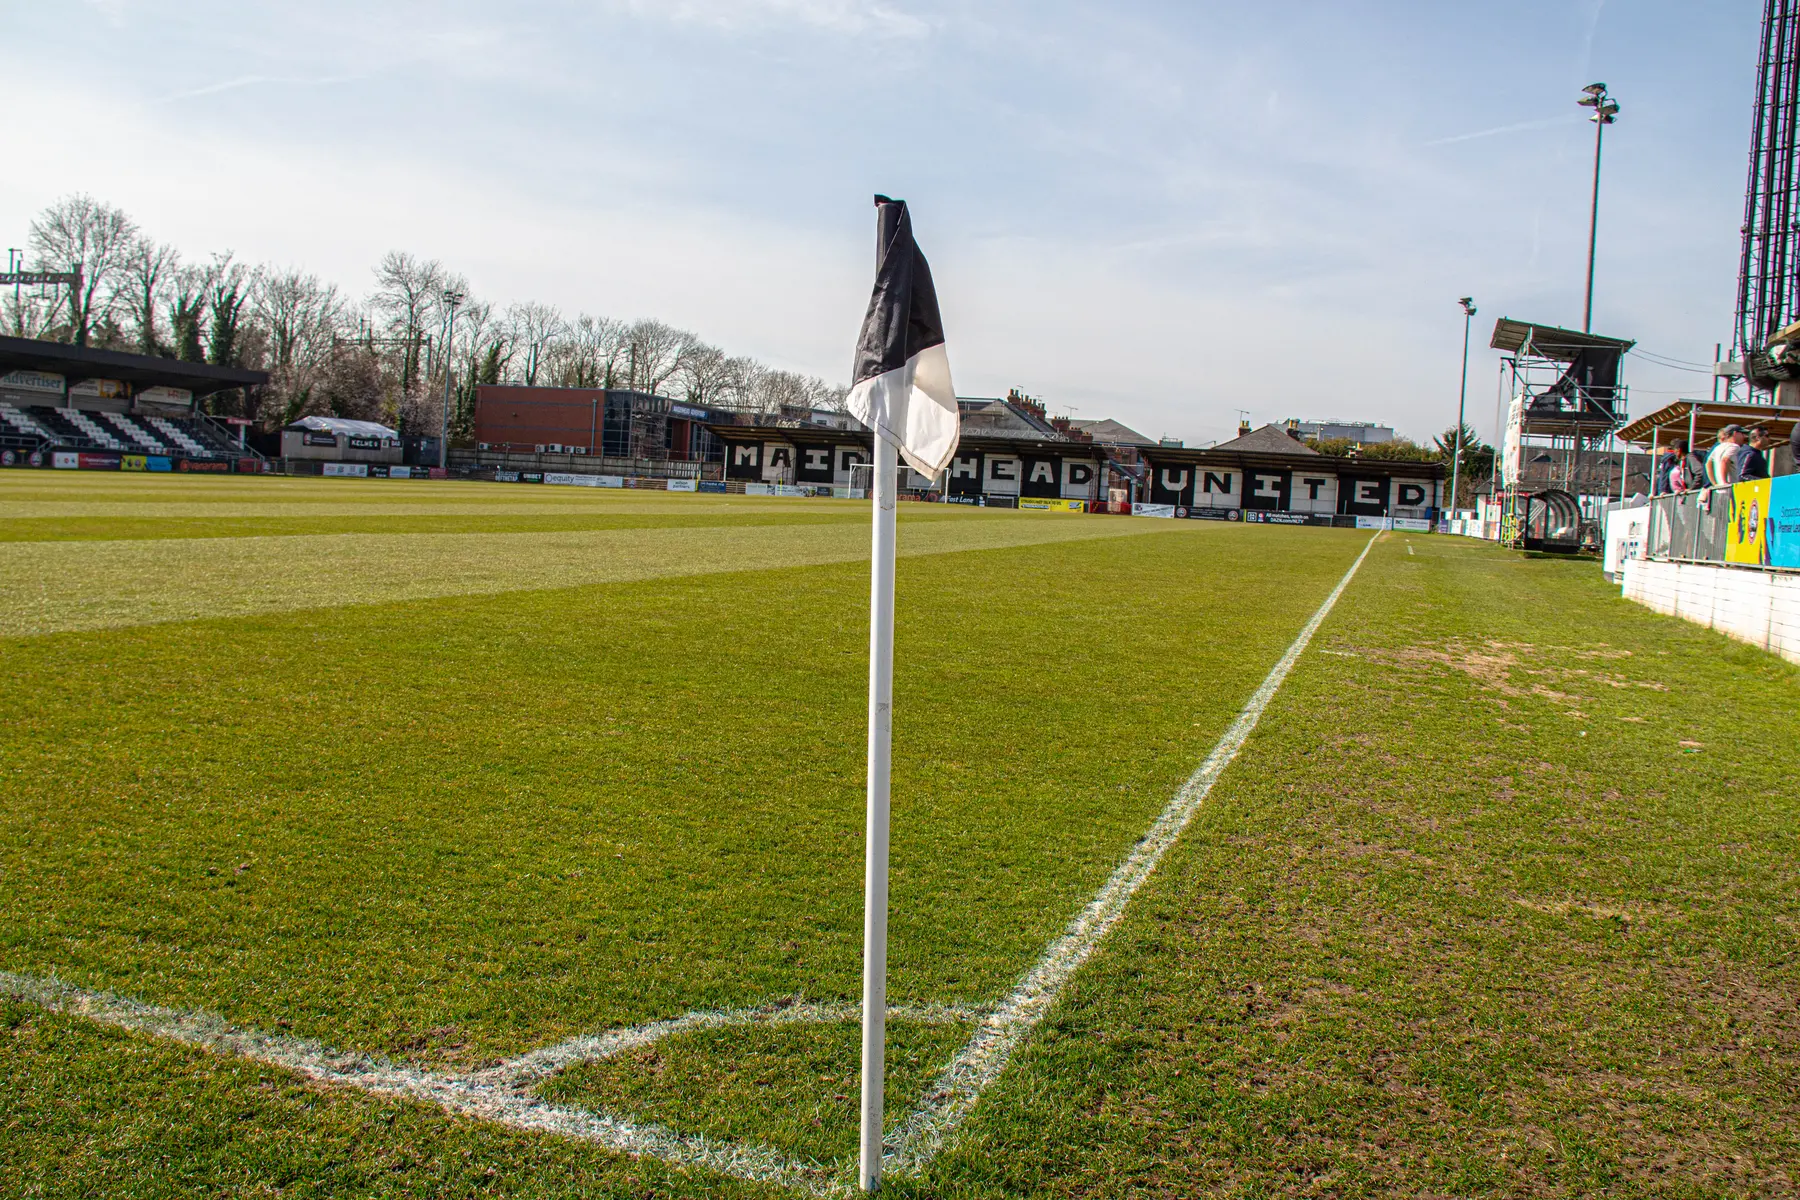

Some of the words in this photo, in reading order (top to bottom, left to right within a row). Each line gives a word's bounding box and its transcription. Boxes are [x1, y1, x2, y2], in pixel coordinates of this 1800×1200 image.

[552, 475, 574, 483] equity
[735, 445, 1093, 484] MAIDHEAD
[1161, 469, 1425, 505] UNITED
